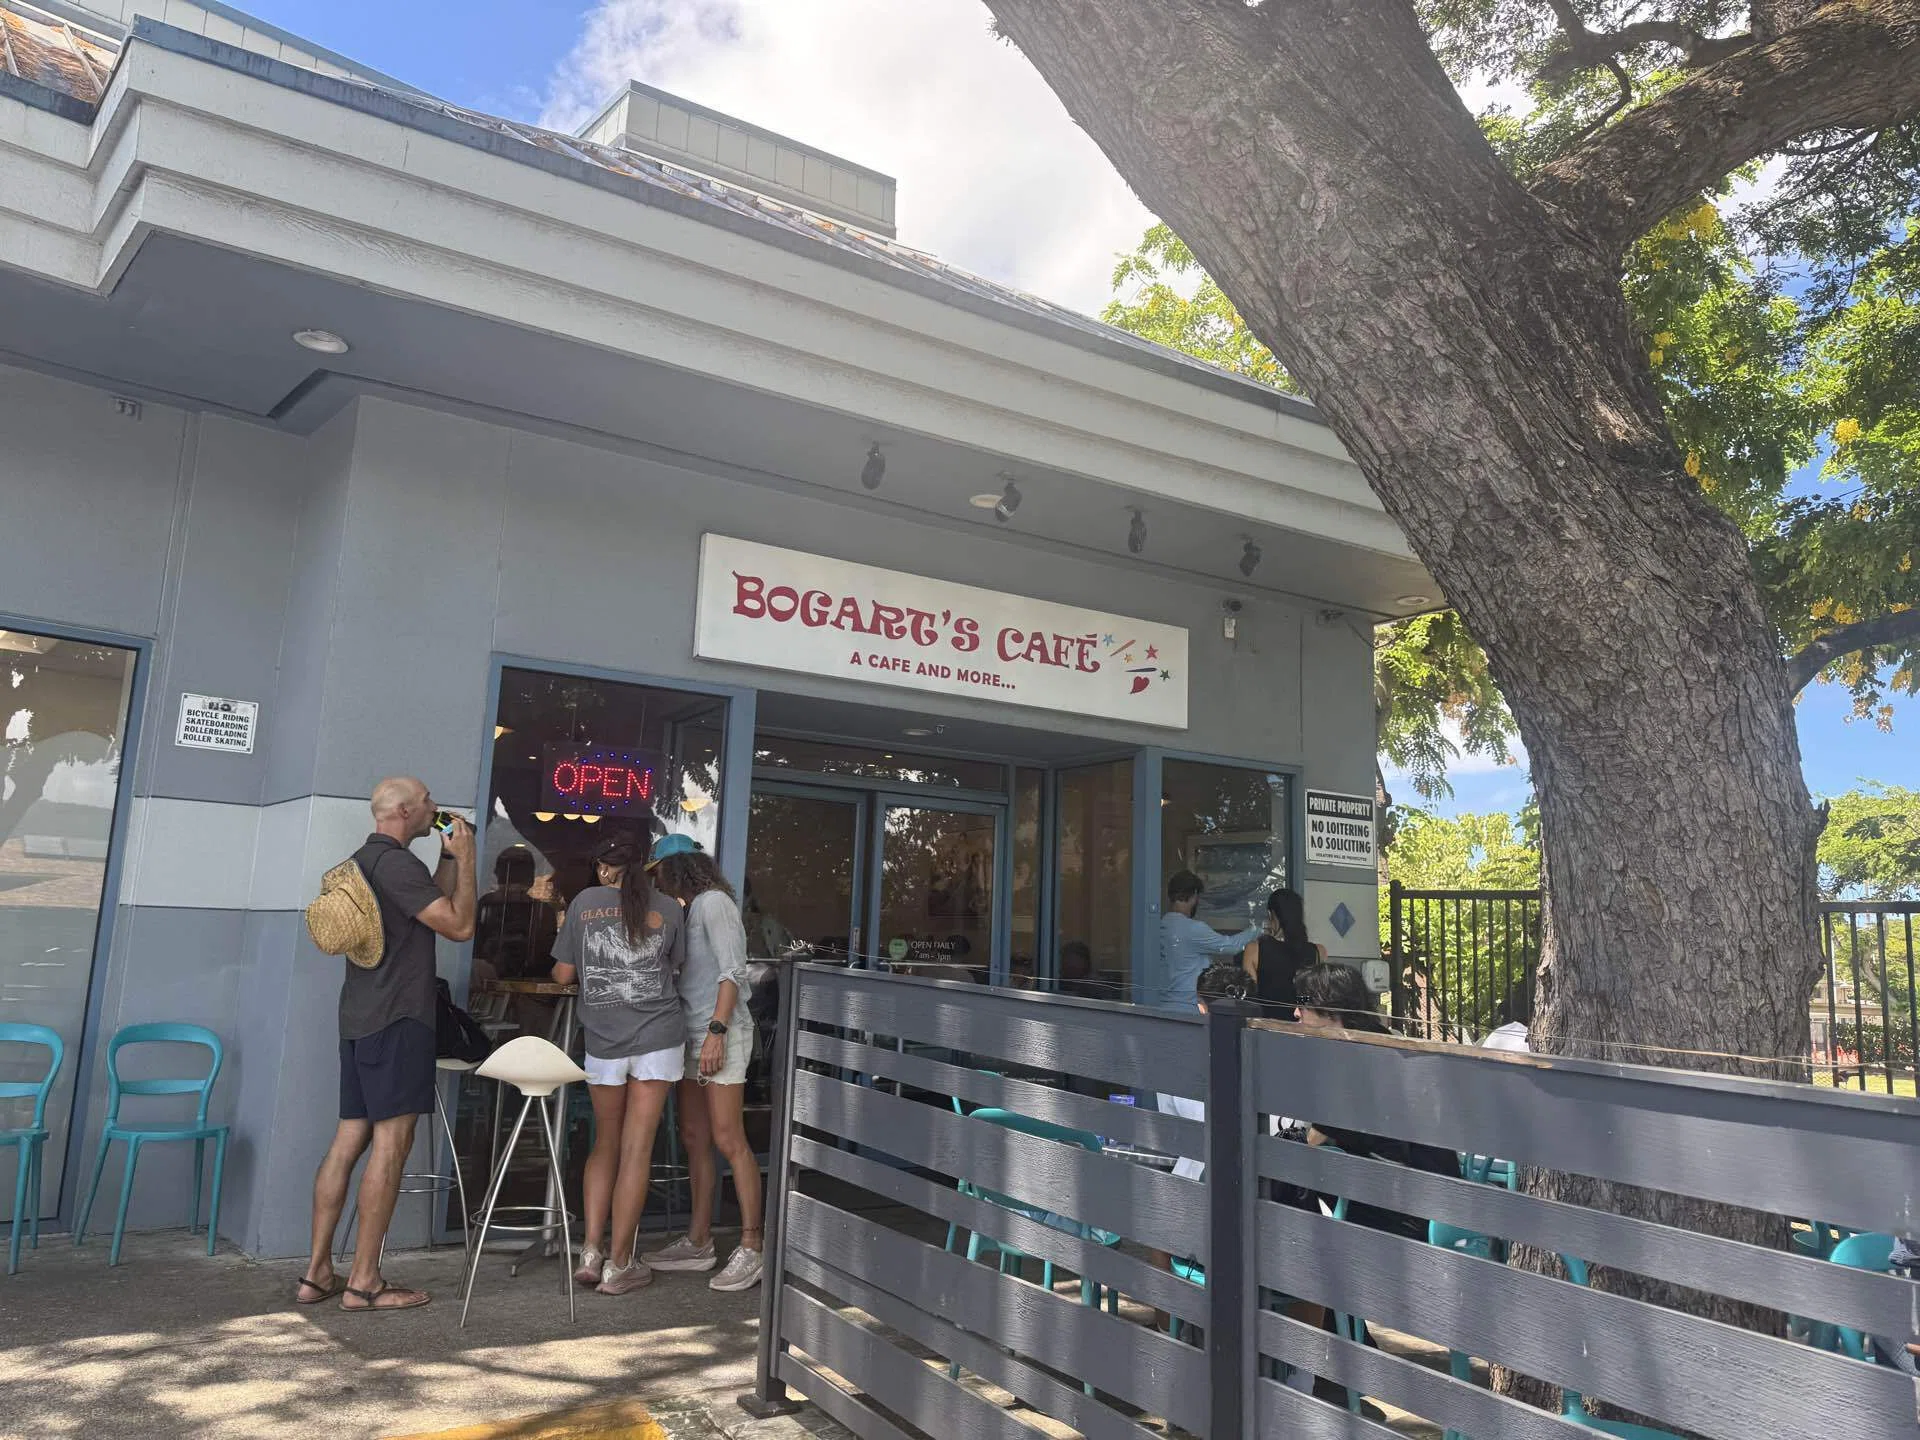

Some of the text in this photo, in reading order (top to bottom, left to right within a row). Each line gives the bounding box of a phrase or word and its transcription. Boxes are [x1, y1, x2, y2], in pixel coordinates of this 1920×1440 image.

[731, 569, 1101, 673] BOGART'S CAFÉ
[849, 651, 1017, 690] A CAFE AND MORE...
[185, 717, 249, 732] SKATEBOARDING
[186, 709, 250, 723] BICYCLE RIDING
[182, 733, 247, 747] ROLLER SKATING
[184, 725, 248, 739] ROLLERBLADING
[553, 762, 651, 799] OPEN
[1309, 797, 1371, 816] PRIVATE PROPERTY
[1311, 820, 1370, 838] NO LOITERING
[1325, 837, 1371, 854] SOLICITING
[911, 941, 932, 949] OPEN
